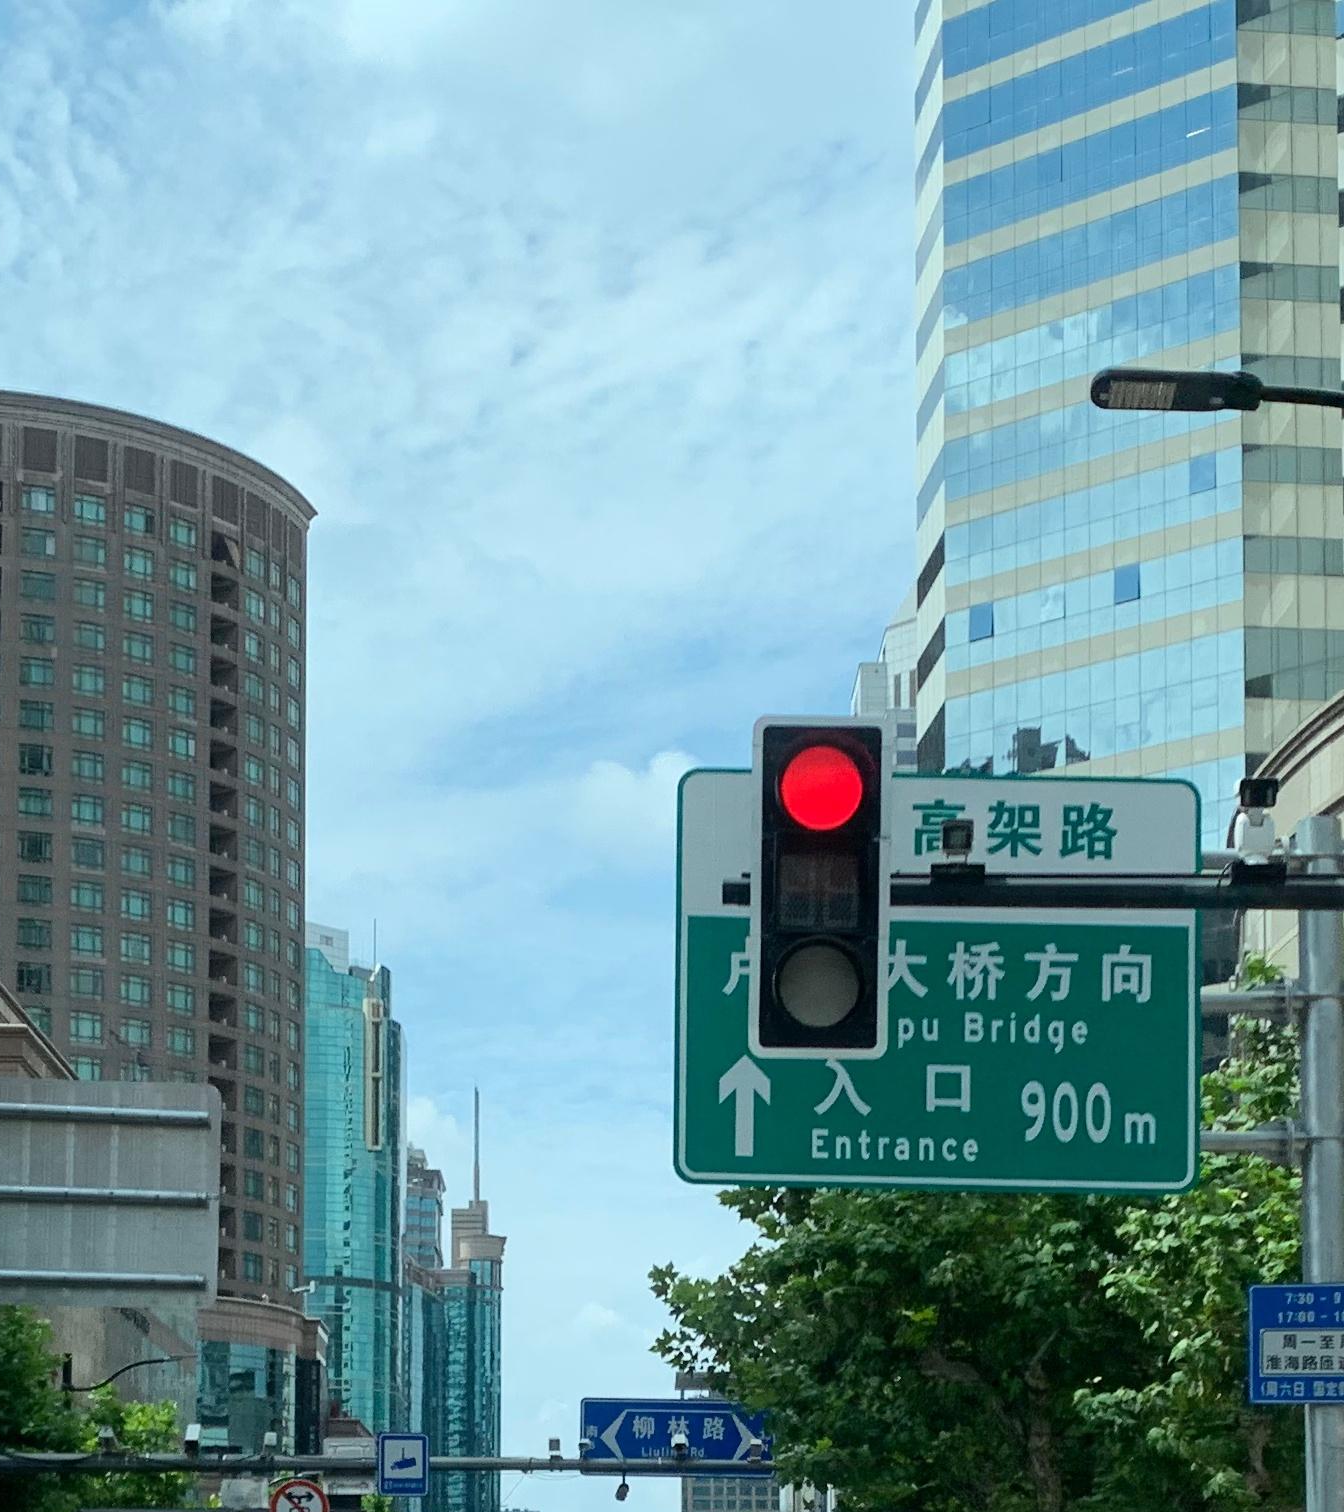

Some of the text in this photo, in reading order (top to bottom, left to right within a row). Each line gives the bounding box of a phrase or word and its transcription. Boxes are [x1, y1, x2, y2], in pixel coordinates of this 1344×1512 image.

[898, 1012, 1088, 1053] pu Bridge
[814, 1059, 971, 1117] 入口
[811, 1128, 979, 1162] Entrance
[632, 1415, 725, 1440] 柳林路
